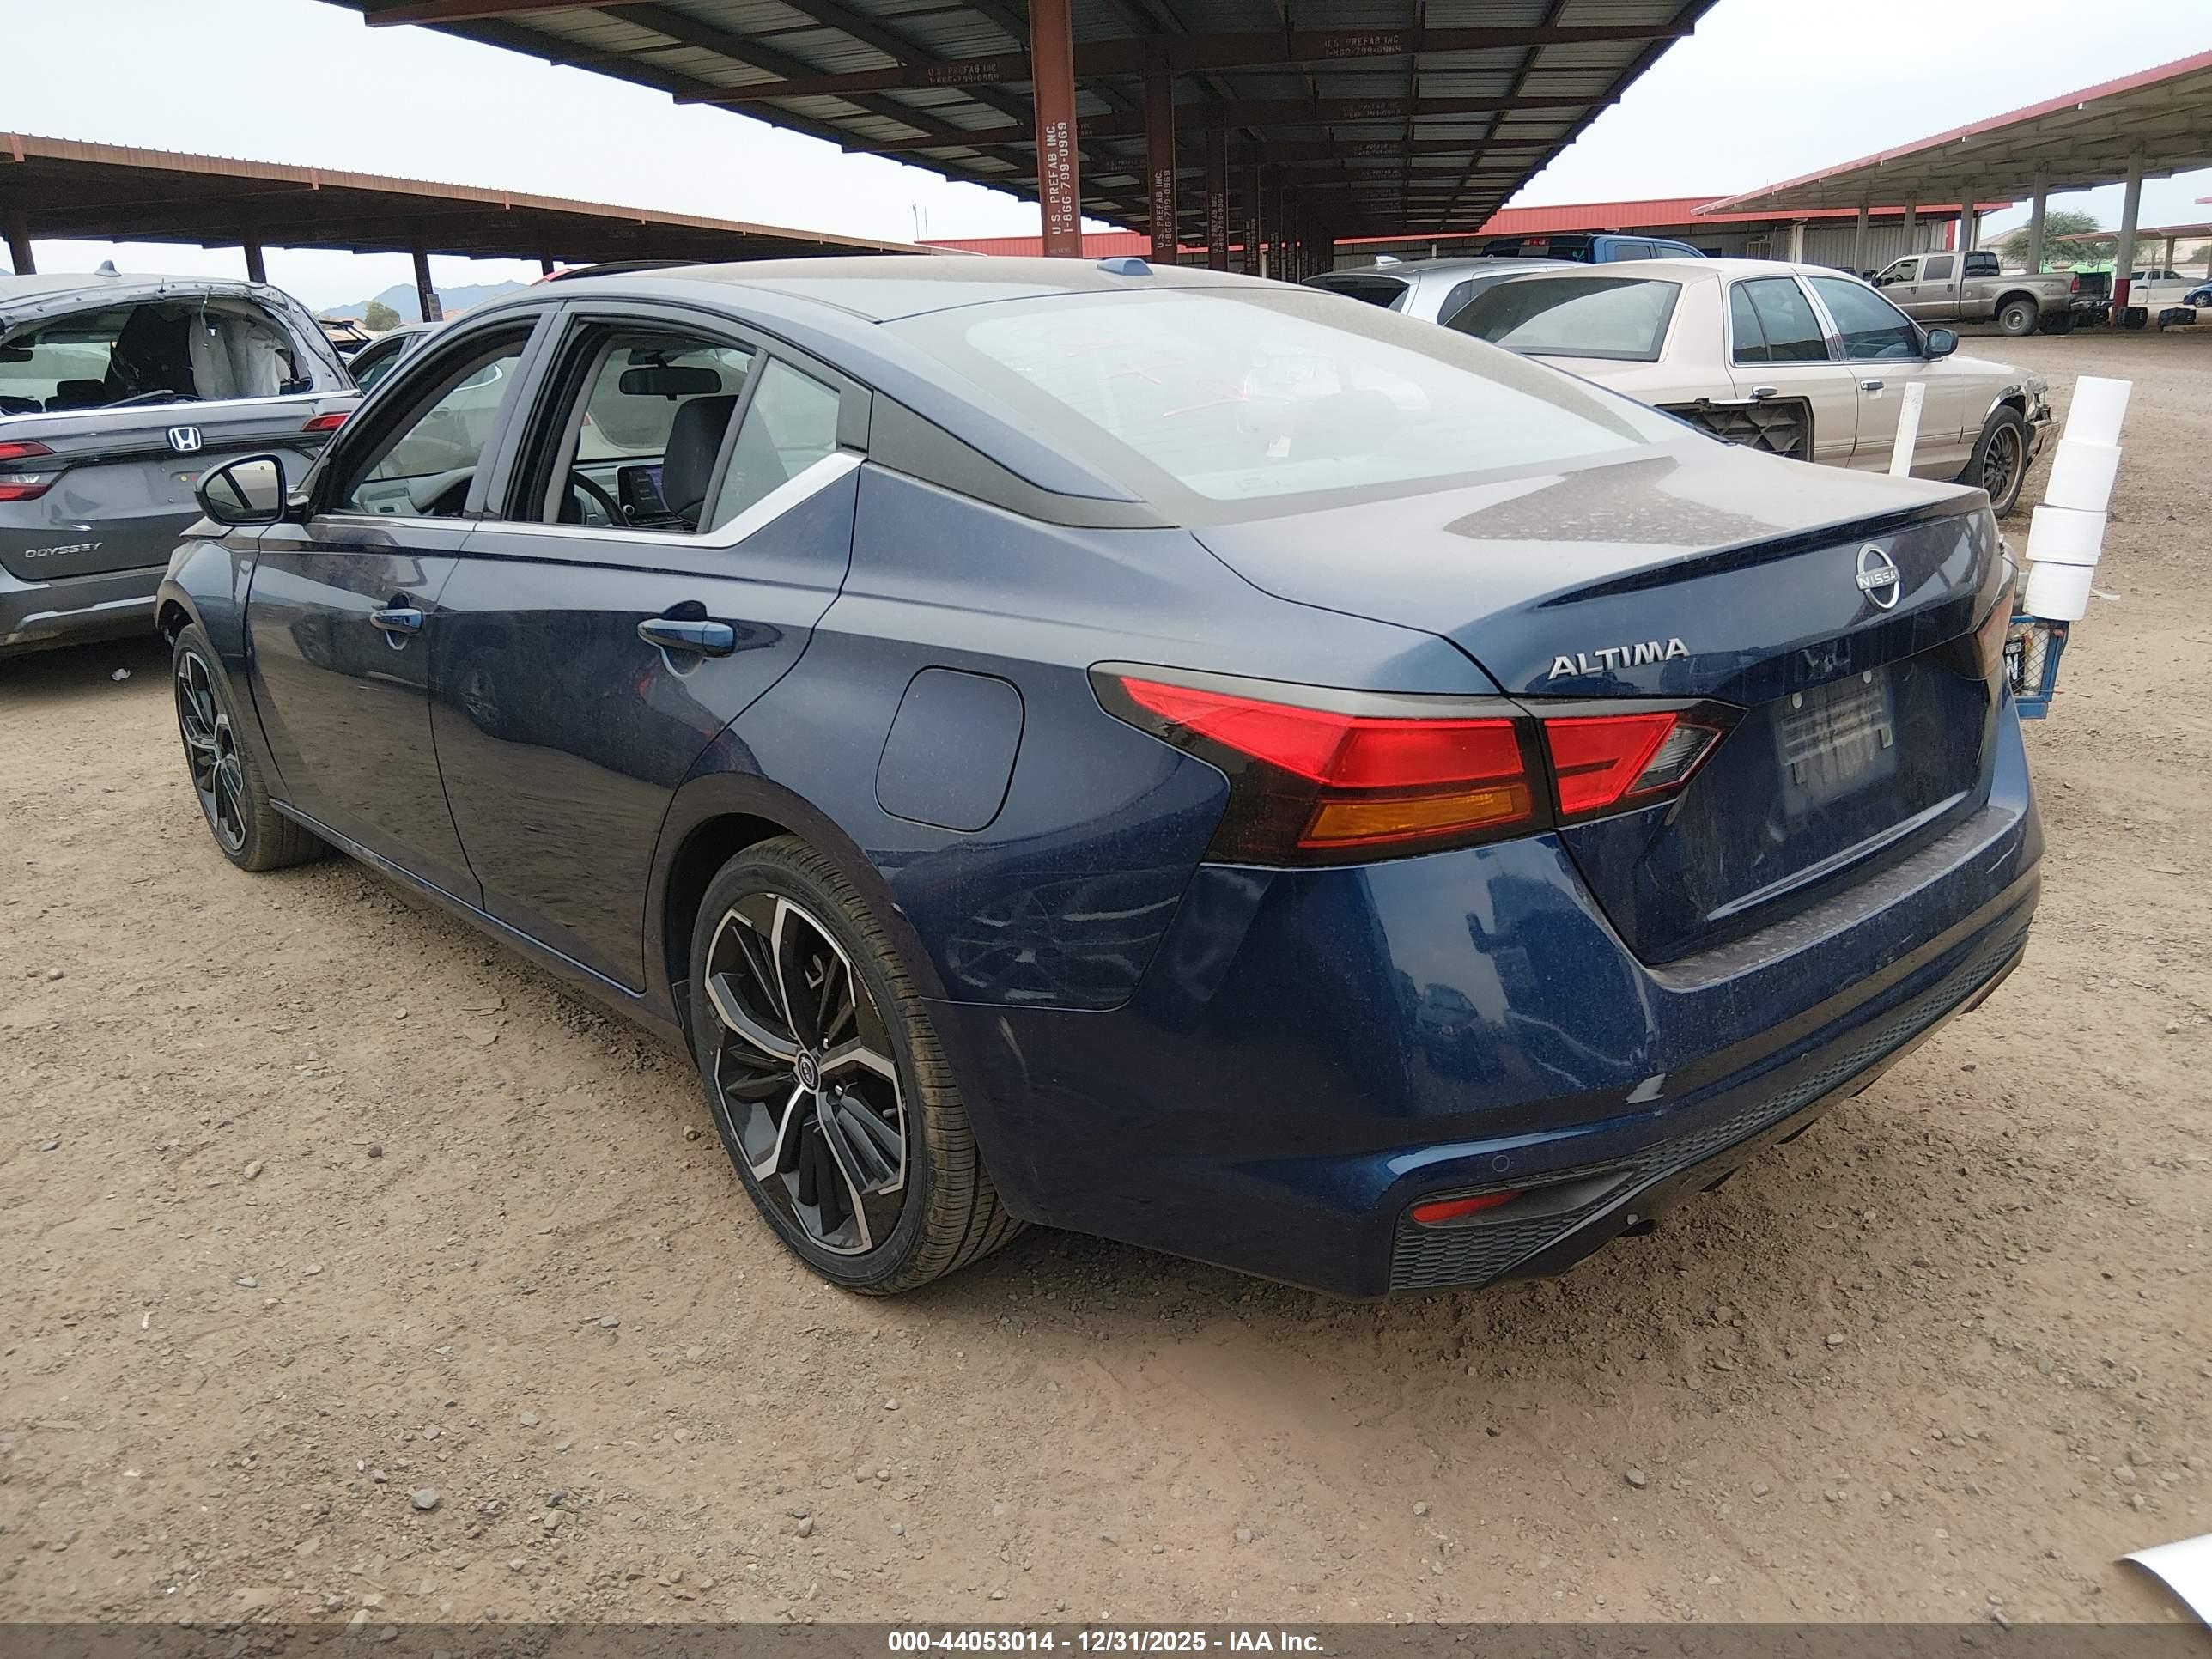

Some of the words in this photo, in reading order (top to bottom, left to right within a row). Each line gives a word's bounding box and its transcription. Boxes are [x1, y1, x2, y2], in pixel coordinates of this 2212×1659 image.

[1046, 121, 1056, 147] INC.
[1048, 153, 1060, 204] PREFAB
[1057, 122, 1073, 233] 1-866-799-0969
[1051, 210, 1062, 234] U.S.
[1155, 191, 1164, 227] PREFAB
[25, 542, 103, 558] ODYSSEY
[1858, 570, 1896, 587] NISSA
[1547, 638, 1691, 680] ALTIMA
